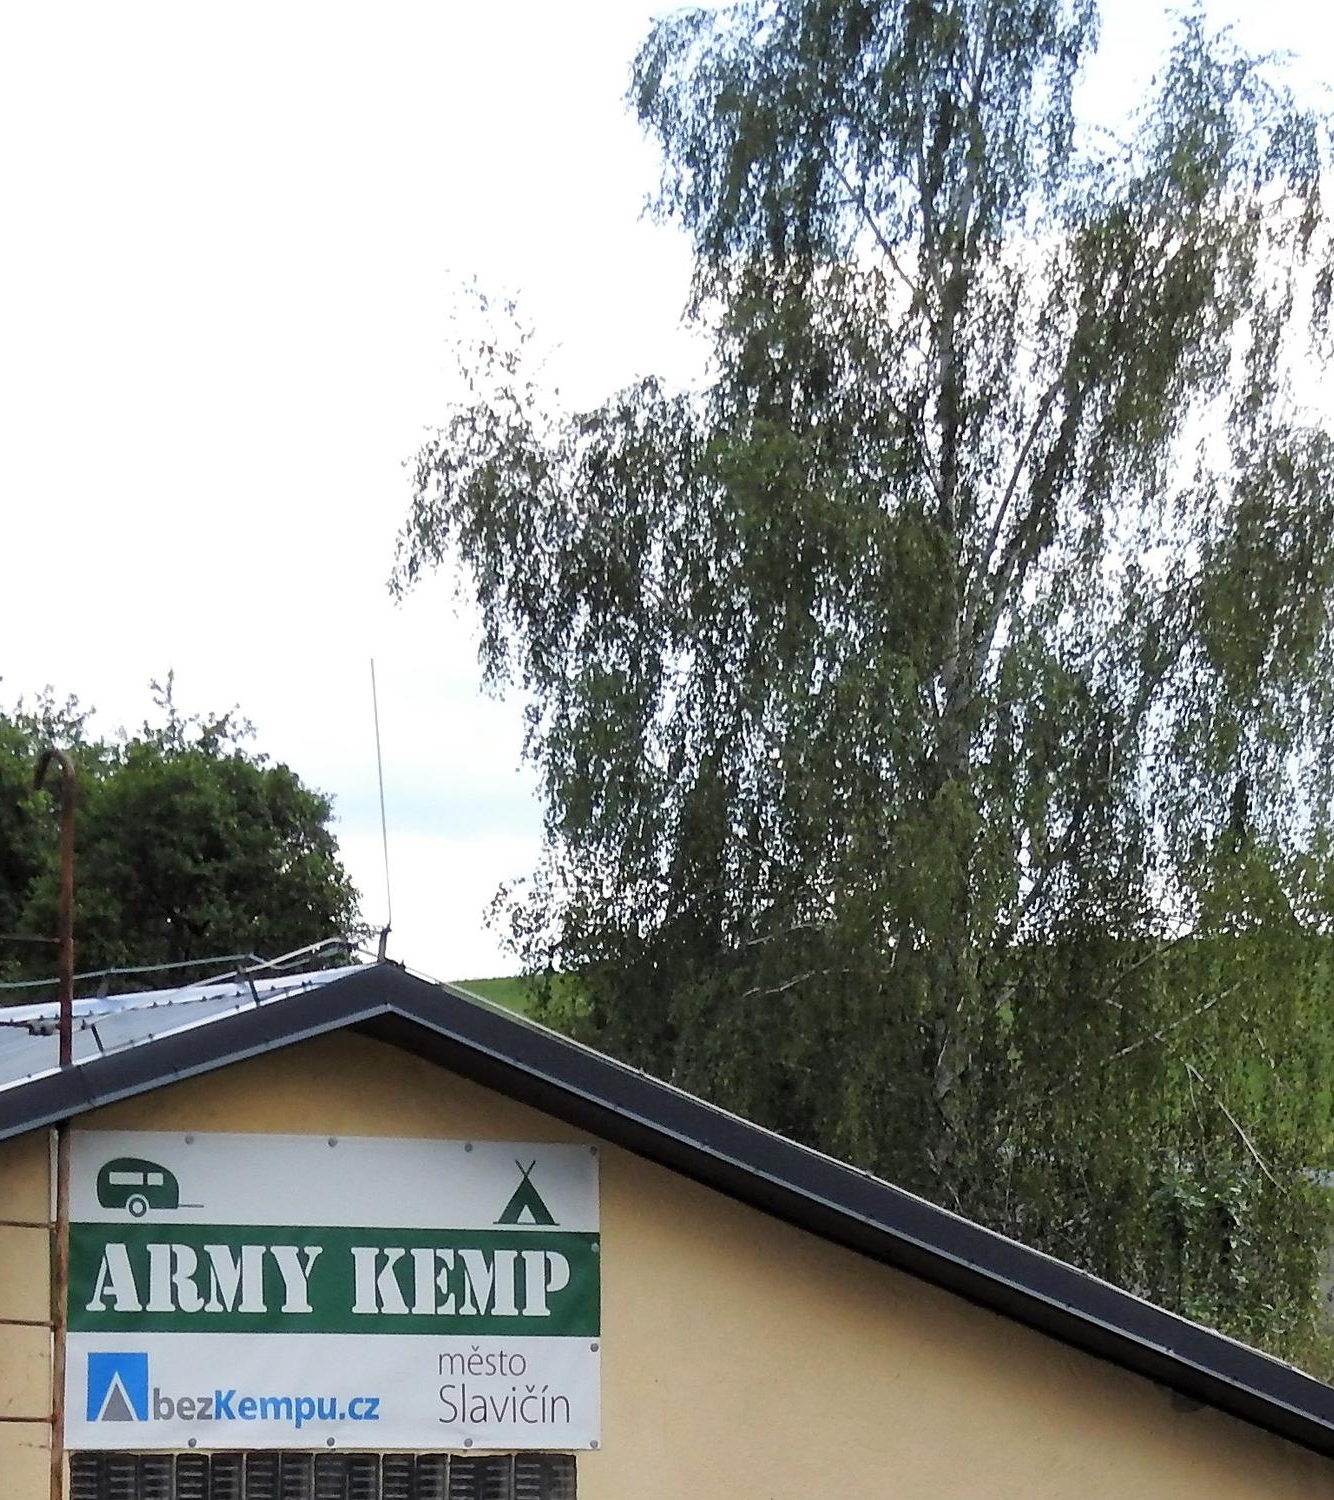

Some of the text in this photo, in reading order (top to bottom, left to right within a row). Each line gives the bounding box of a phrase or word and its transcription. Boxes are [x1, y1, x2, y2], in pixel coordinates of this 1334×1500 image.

[86, 1242, 571, 1317] ARMY KEMP
[438, 1346, 527, 1377] město
[154, 1388, 380, 1428] bezKempu.cz
[438, 1384, 570, 1424] Slavičín
